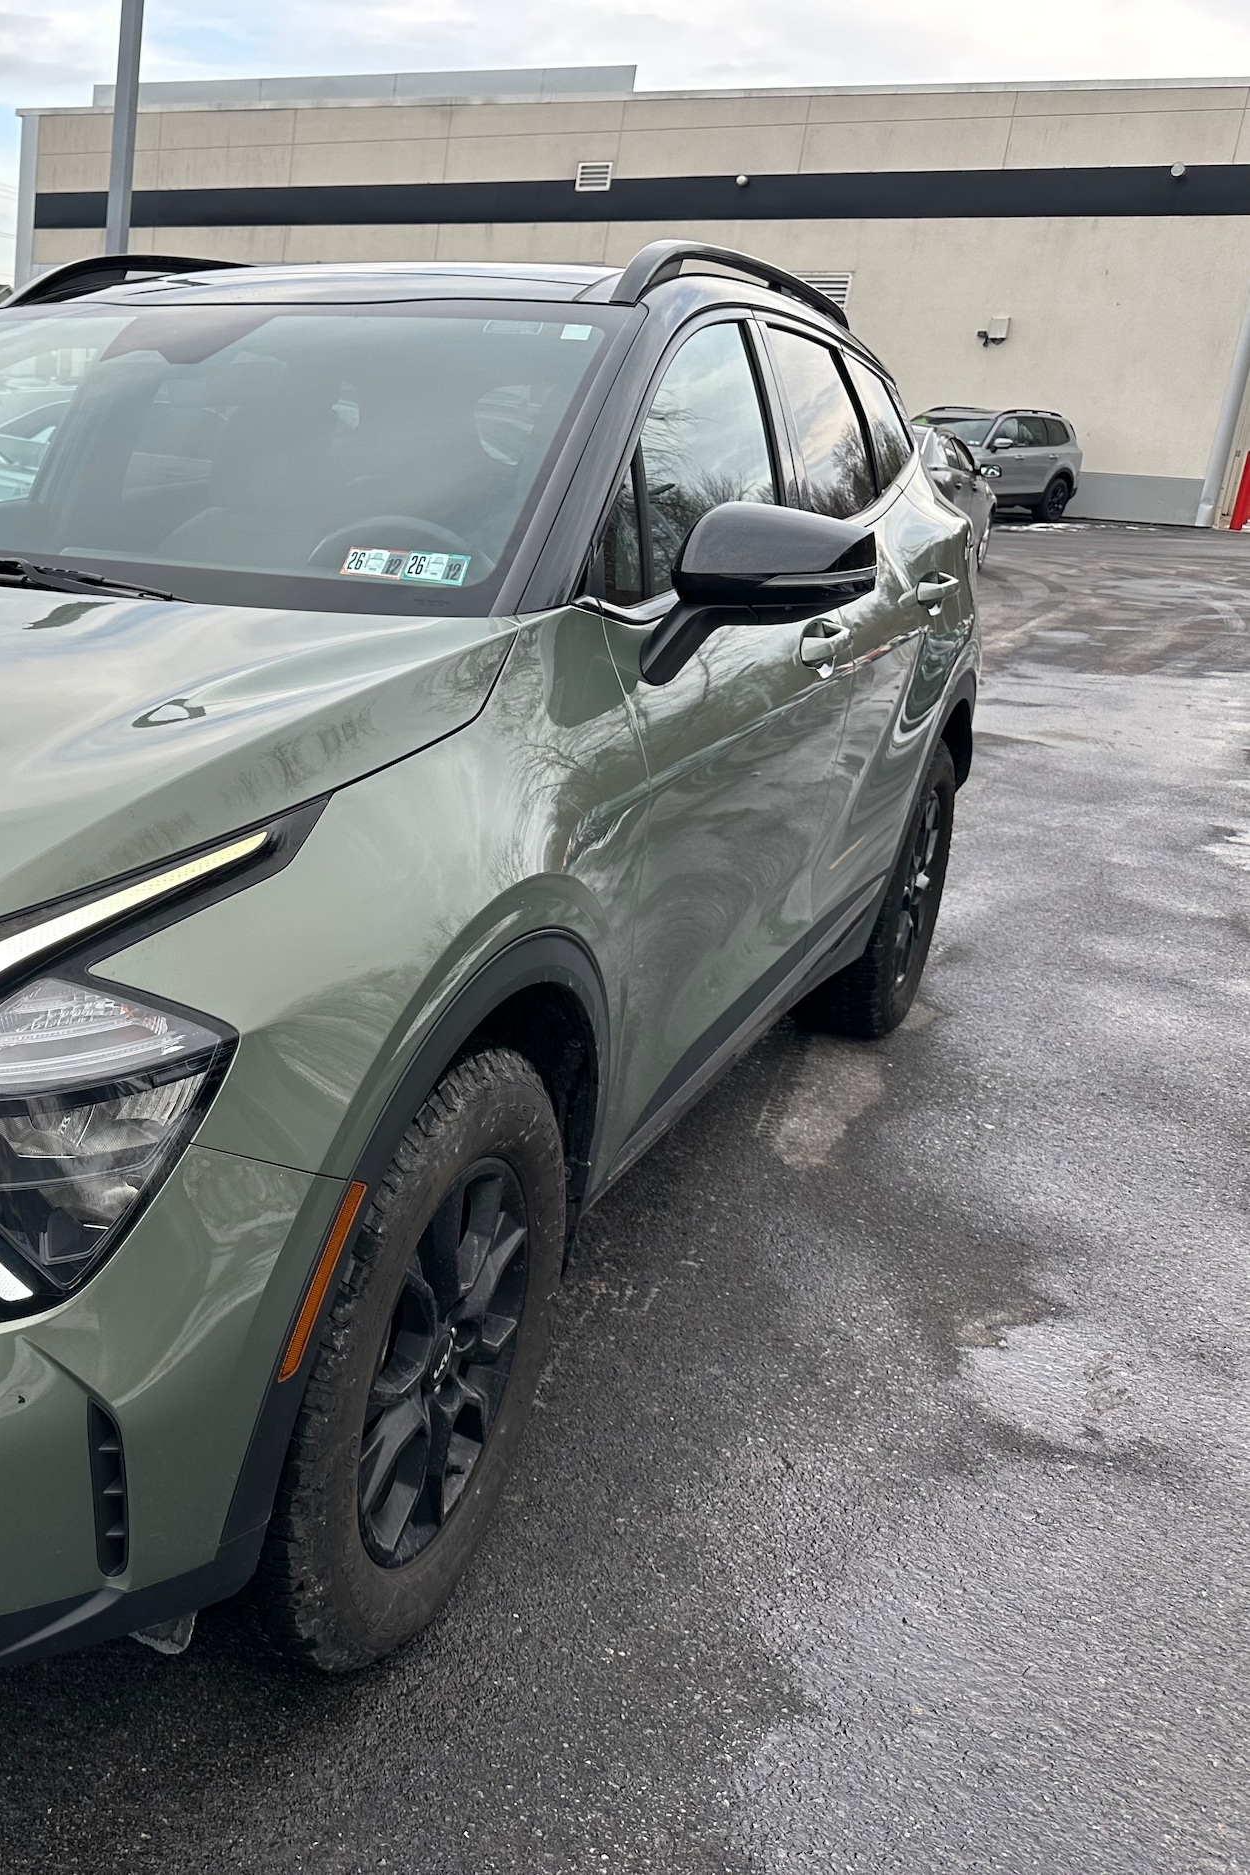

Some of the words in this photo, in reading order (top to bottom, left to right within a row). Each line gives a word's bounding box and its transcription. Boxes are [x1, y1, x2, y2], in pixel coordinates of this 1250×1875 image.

[346, 551, 366, 571] 26
[384, 558, 403, 576] 12
[406, 555, 427, 575] 26
[444, 562, 462, 581] 12
